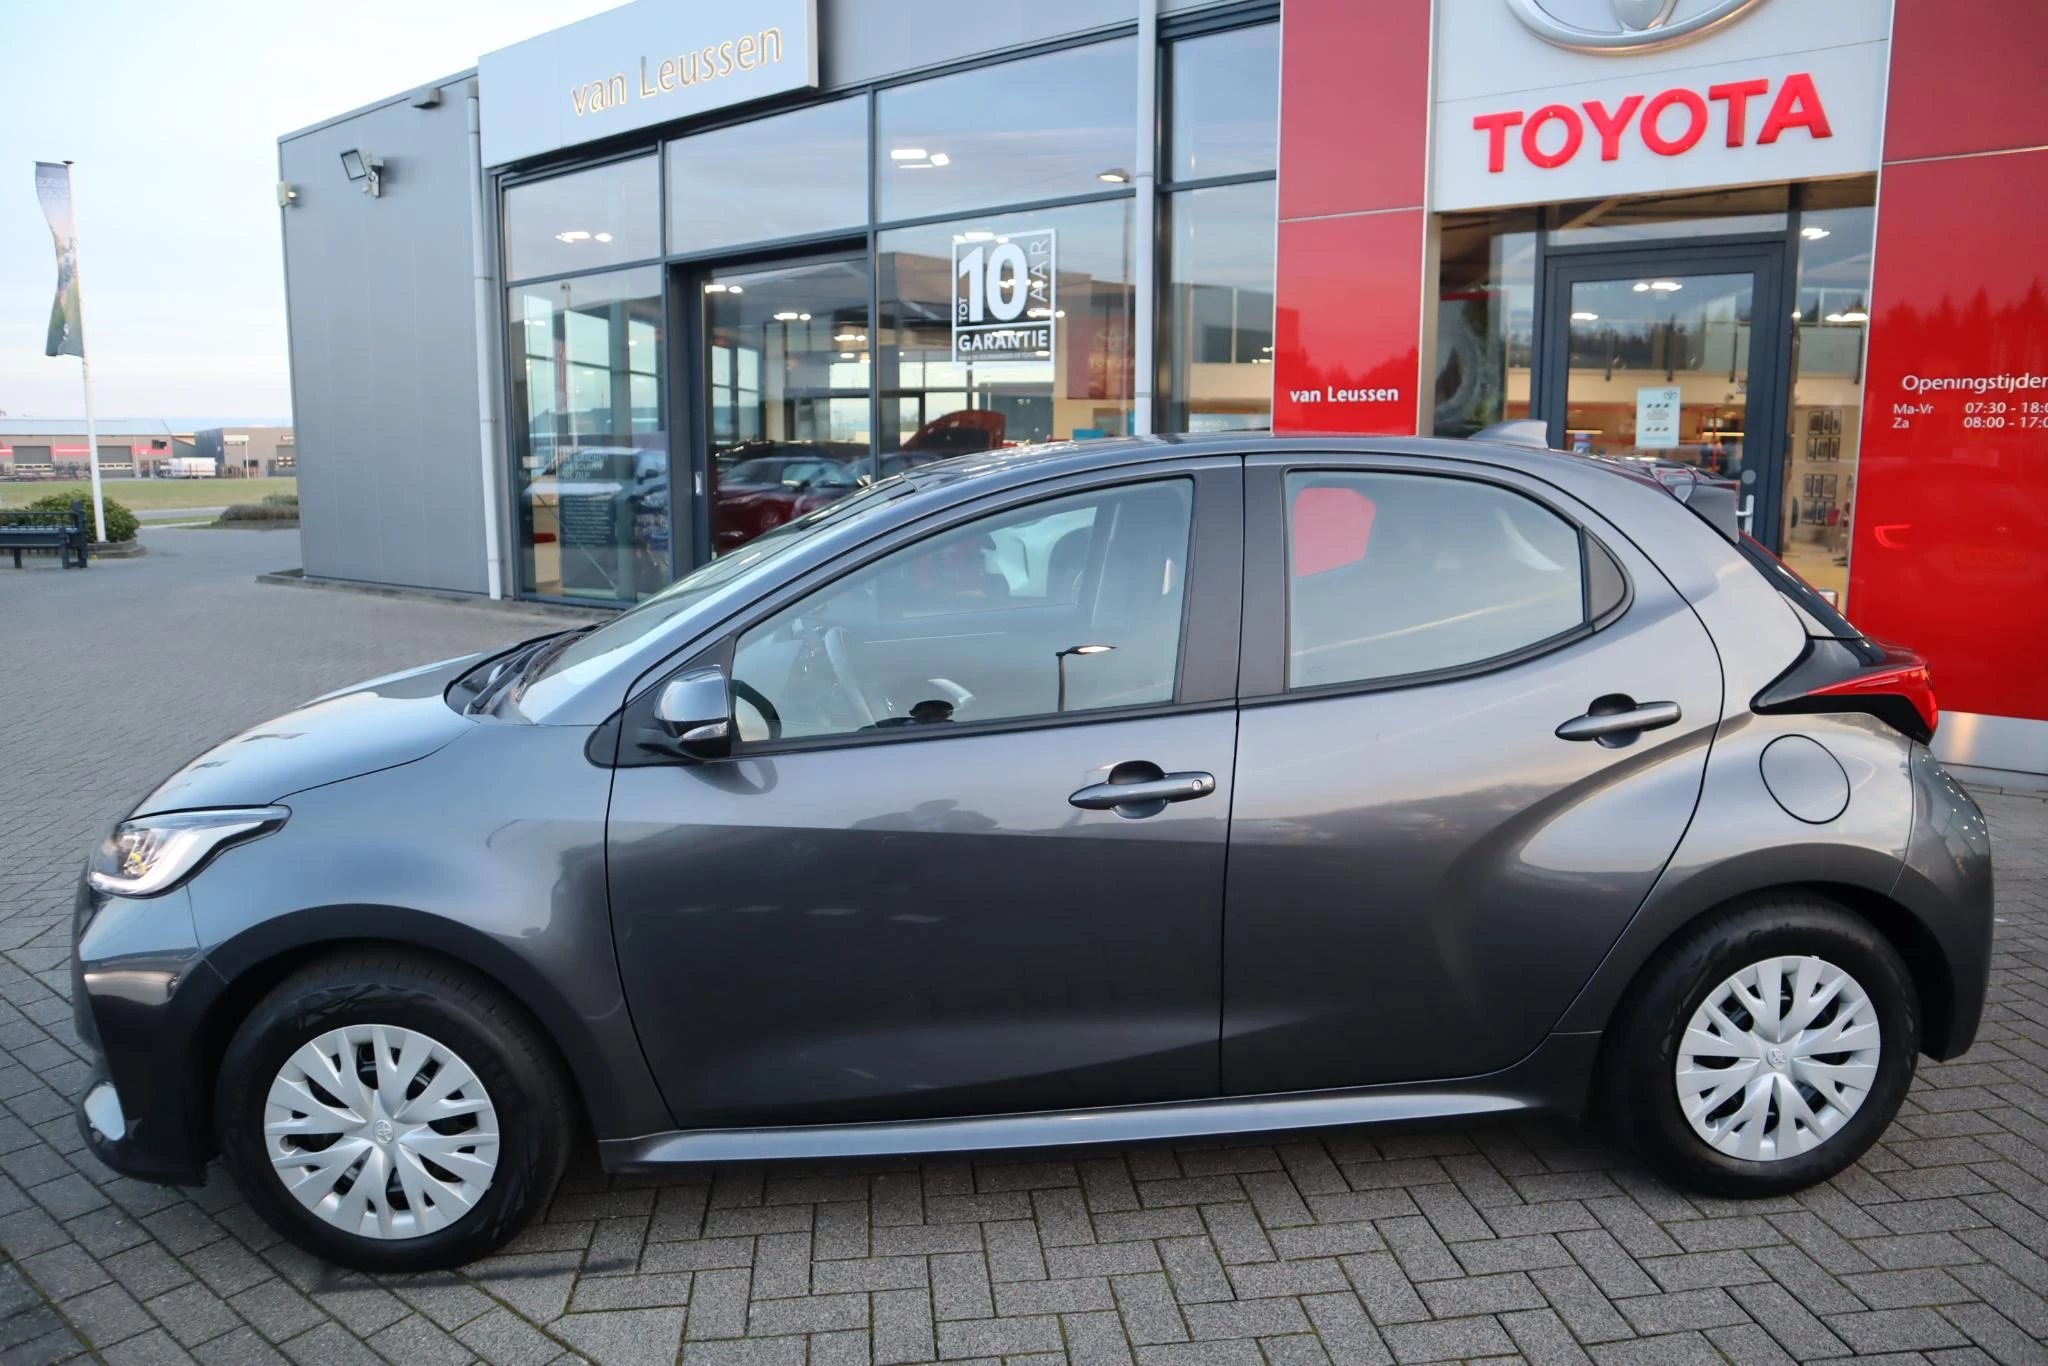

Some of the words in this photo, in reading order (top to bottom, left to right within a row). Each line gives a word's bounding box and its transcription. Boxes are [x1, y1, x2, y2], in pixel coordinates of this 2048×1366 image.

[571, 72, 627, 117] van
[638, 26, 783, 99] Leussen
[1473, 73, 1833, 174] TOYOTA
[958, 242, 1029, 323] 10
[958, 296, 969, 323] TOT
[958, 329, 1049, 352] GARANTIE
[1290, 390, 1322, 403] van
[1327, 385, 1399, 403] Leussen
[1893, 403, 1934, 415] Ma-Vr
[1965, 402, 2007, 414] 07:30
[1892, 417, 1910, 429] Za
[1963, 417, 2005, 428] 08:00
